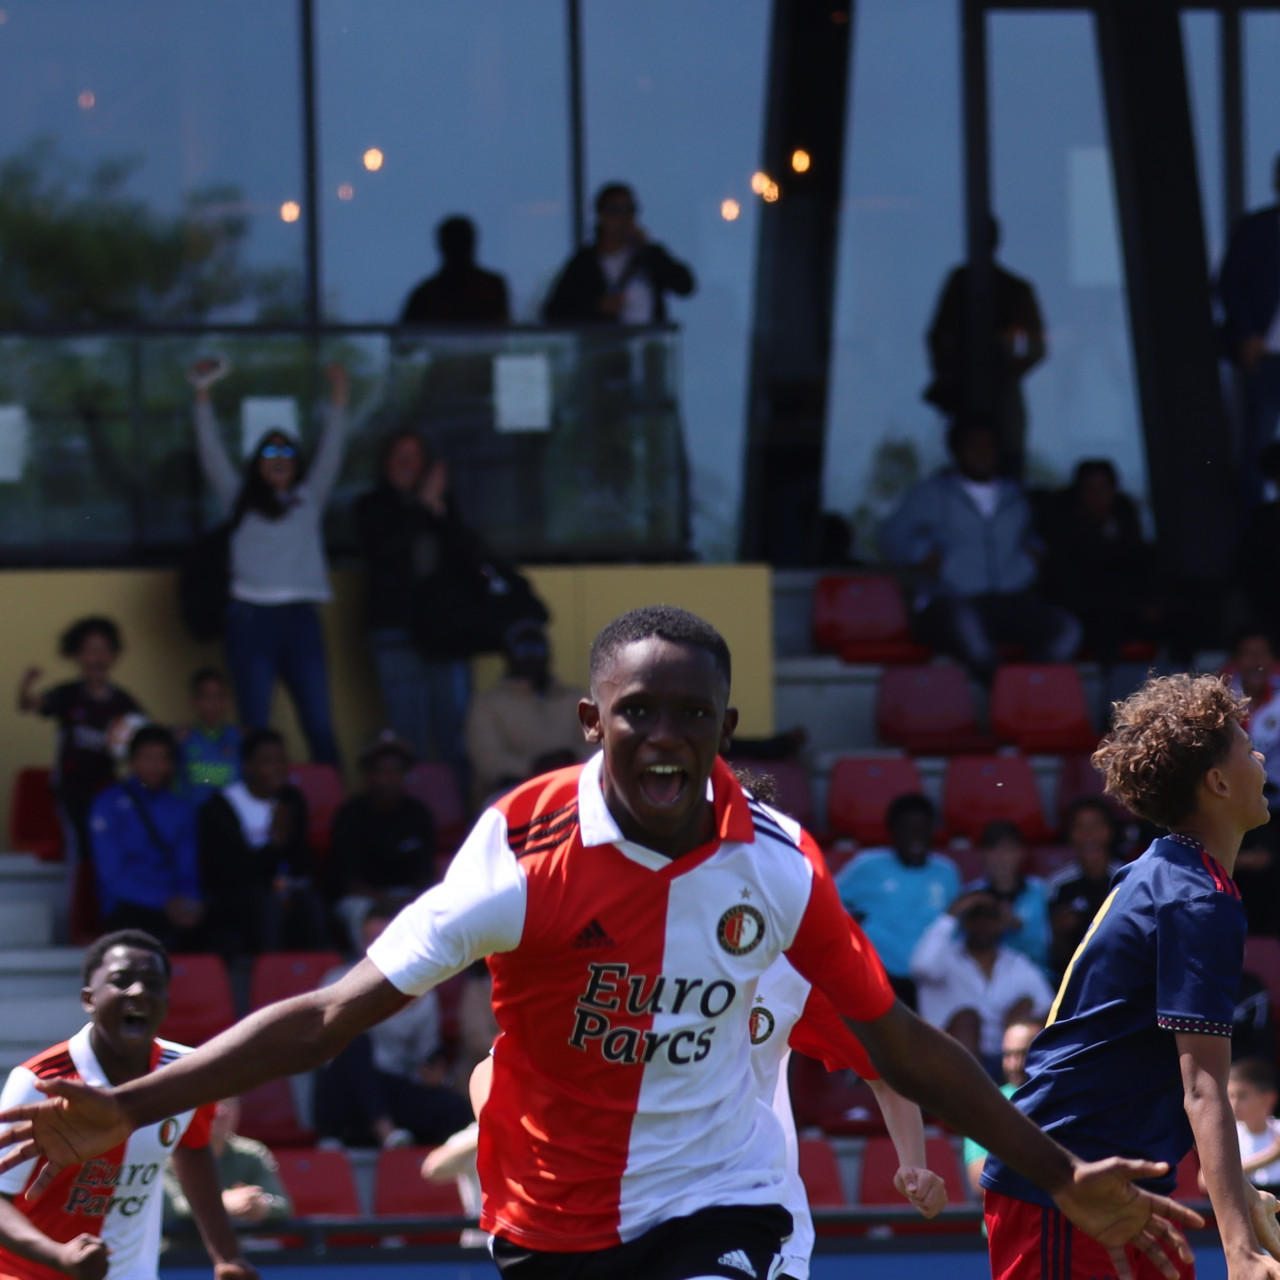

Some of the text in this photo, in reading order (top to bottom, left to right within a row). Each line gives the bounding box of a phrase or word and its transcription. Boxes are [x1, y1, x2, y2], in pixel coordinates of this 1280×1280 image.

[578, 962, 737, 1019] Euro
[568, 1005, 717, 1066] Parcs
[77, 1159, 158, 1187] Euro
[65, 1186, 149, 1217] Parcs
